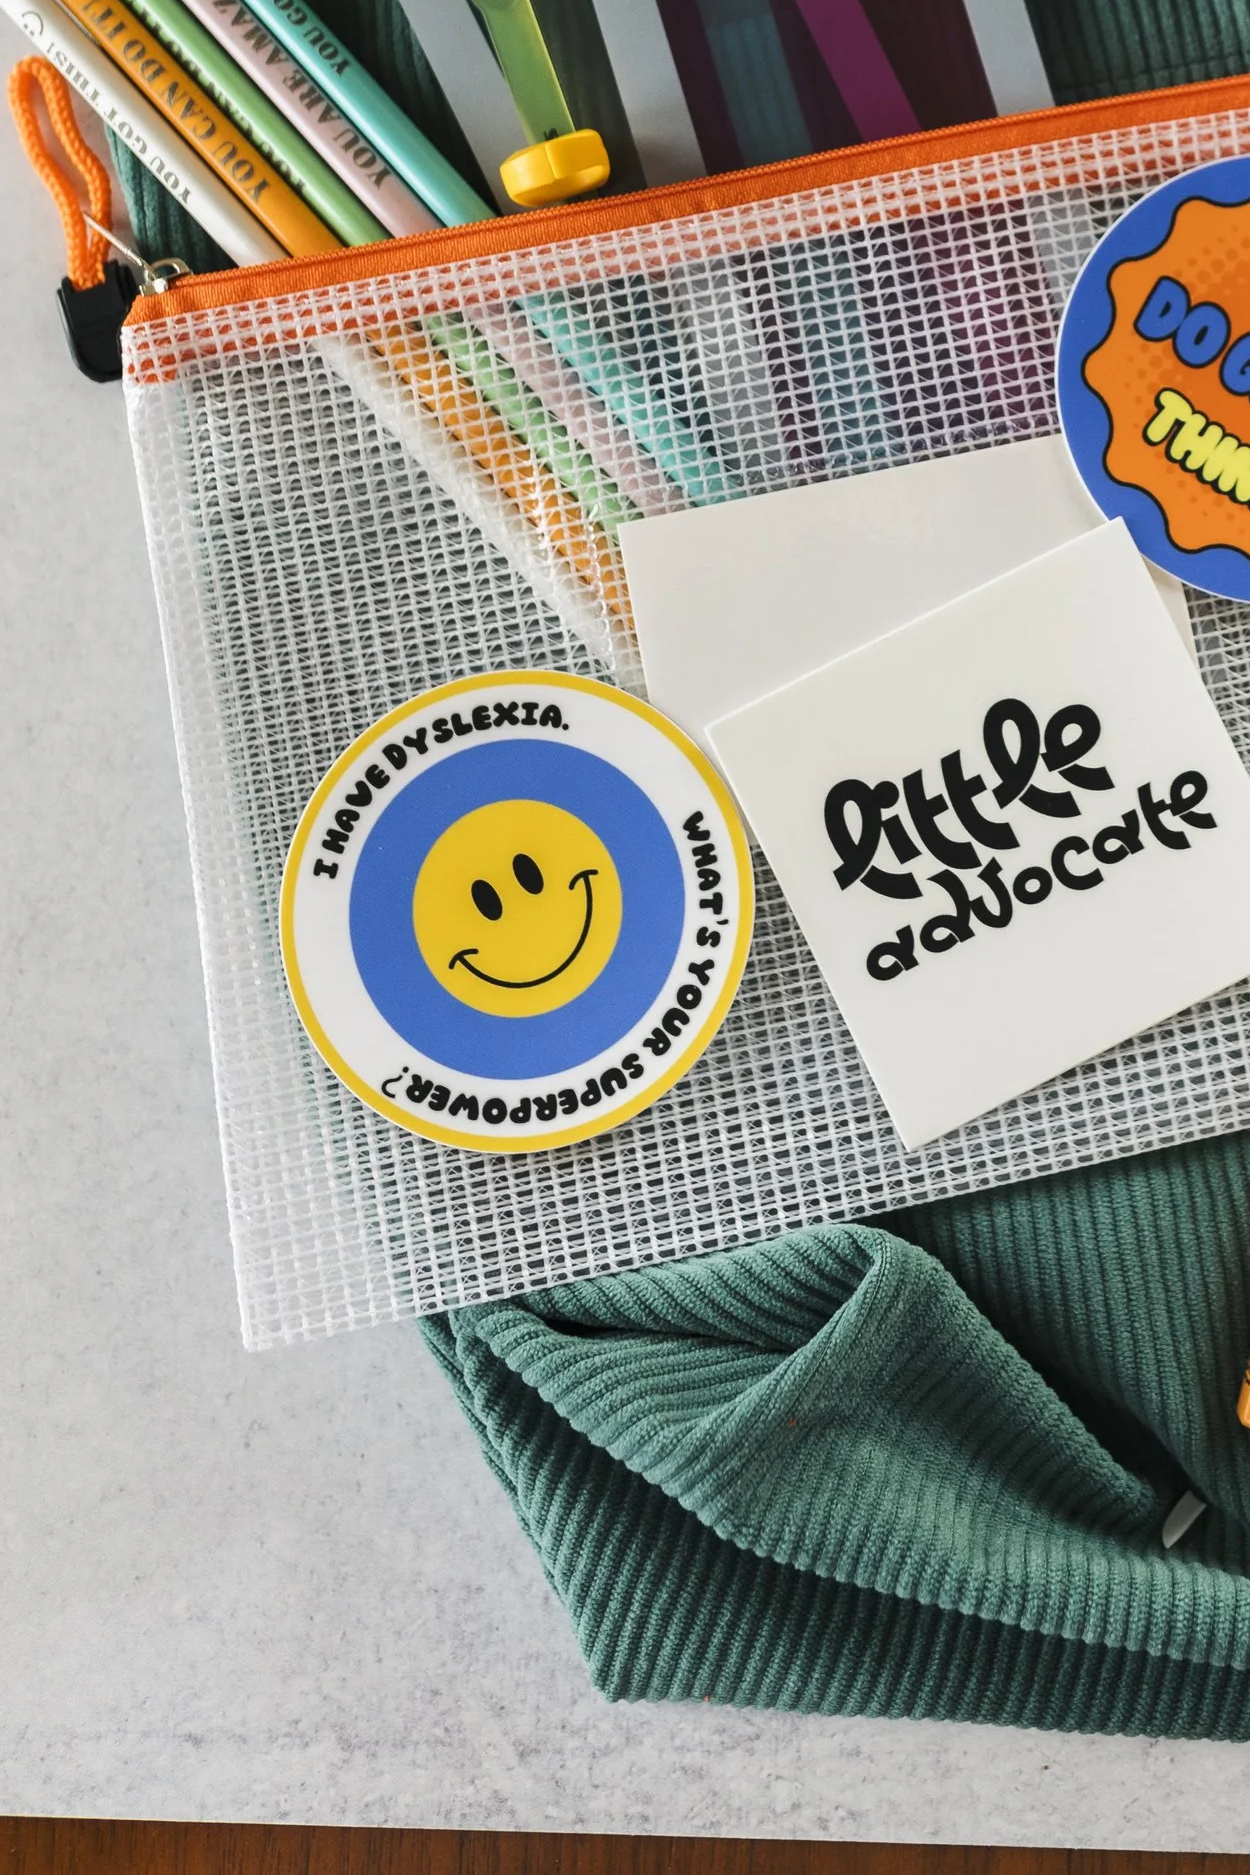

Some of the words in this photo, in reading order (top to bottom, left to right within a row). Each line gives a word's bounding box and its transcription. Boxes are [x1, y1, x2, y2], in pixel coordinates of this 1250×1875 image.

[46, 42, 102, 106] THIS!
[122, 39, 167, 82] DO
[302, 27, 353, 77] YOU
[104, 107, 147, 155] GOT
[159, 81, 217, 140] CAN
[283, 75, 341, 125] ARE
[150, 156, 191, 204] YOU
[213, 140, 271, 202] YOU
[334, 128, 394, 190] YOU
[1134, 275, 1232, 368] DO
[314, 858, 339, 880] I
[327, 764, 391, 855] HAVE
[382, 701, 570, 771] DYSLEXIA.
[824, 697, 1115, 900] little
[682, 810, 730, 949] WHAT'S
[866, 770, 1218, 981] advocate
[643, 958, 715, 1057] YOUR
[381, 1052, 646, 1126] SUPERPOWER?
